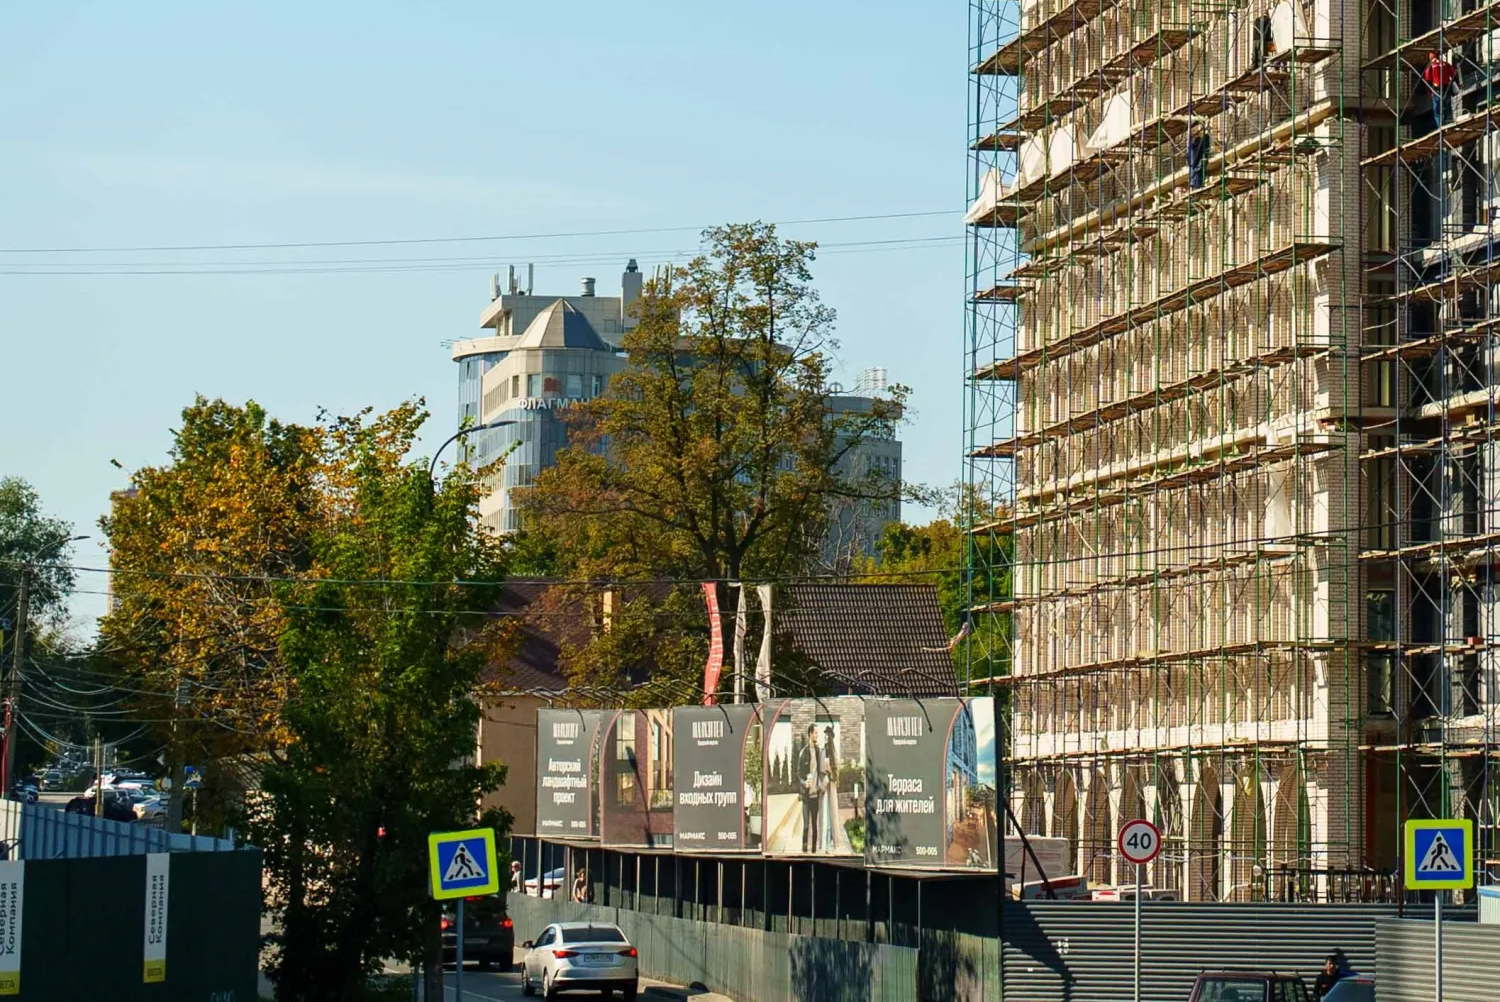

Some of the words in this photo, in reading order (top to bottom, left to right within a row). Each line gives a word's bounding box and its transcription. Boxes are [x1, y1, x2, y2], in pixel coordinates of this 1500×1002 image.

[693, 771, 722, 788] Дизайн
[887, 774, 923, 796] Терраса
[679, 792, 714, 806] входных
[714, 791, 737, 807] групп
[876, 799, 893, 814] для
[895, 796, 934, 814] жителей
[1126, 832, 1152, 849] 40
[6, 882, 17, 955] Компания
[148, 874, 158, 945] Северная
